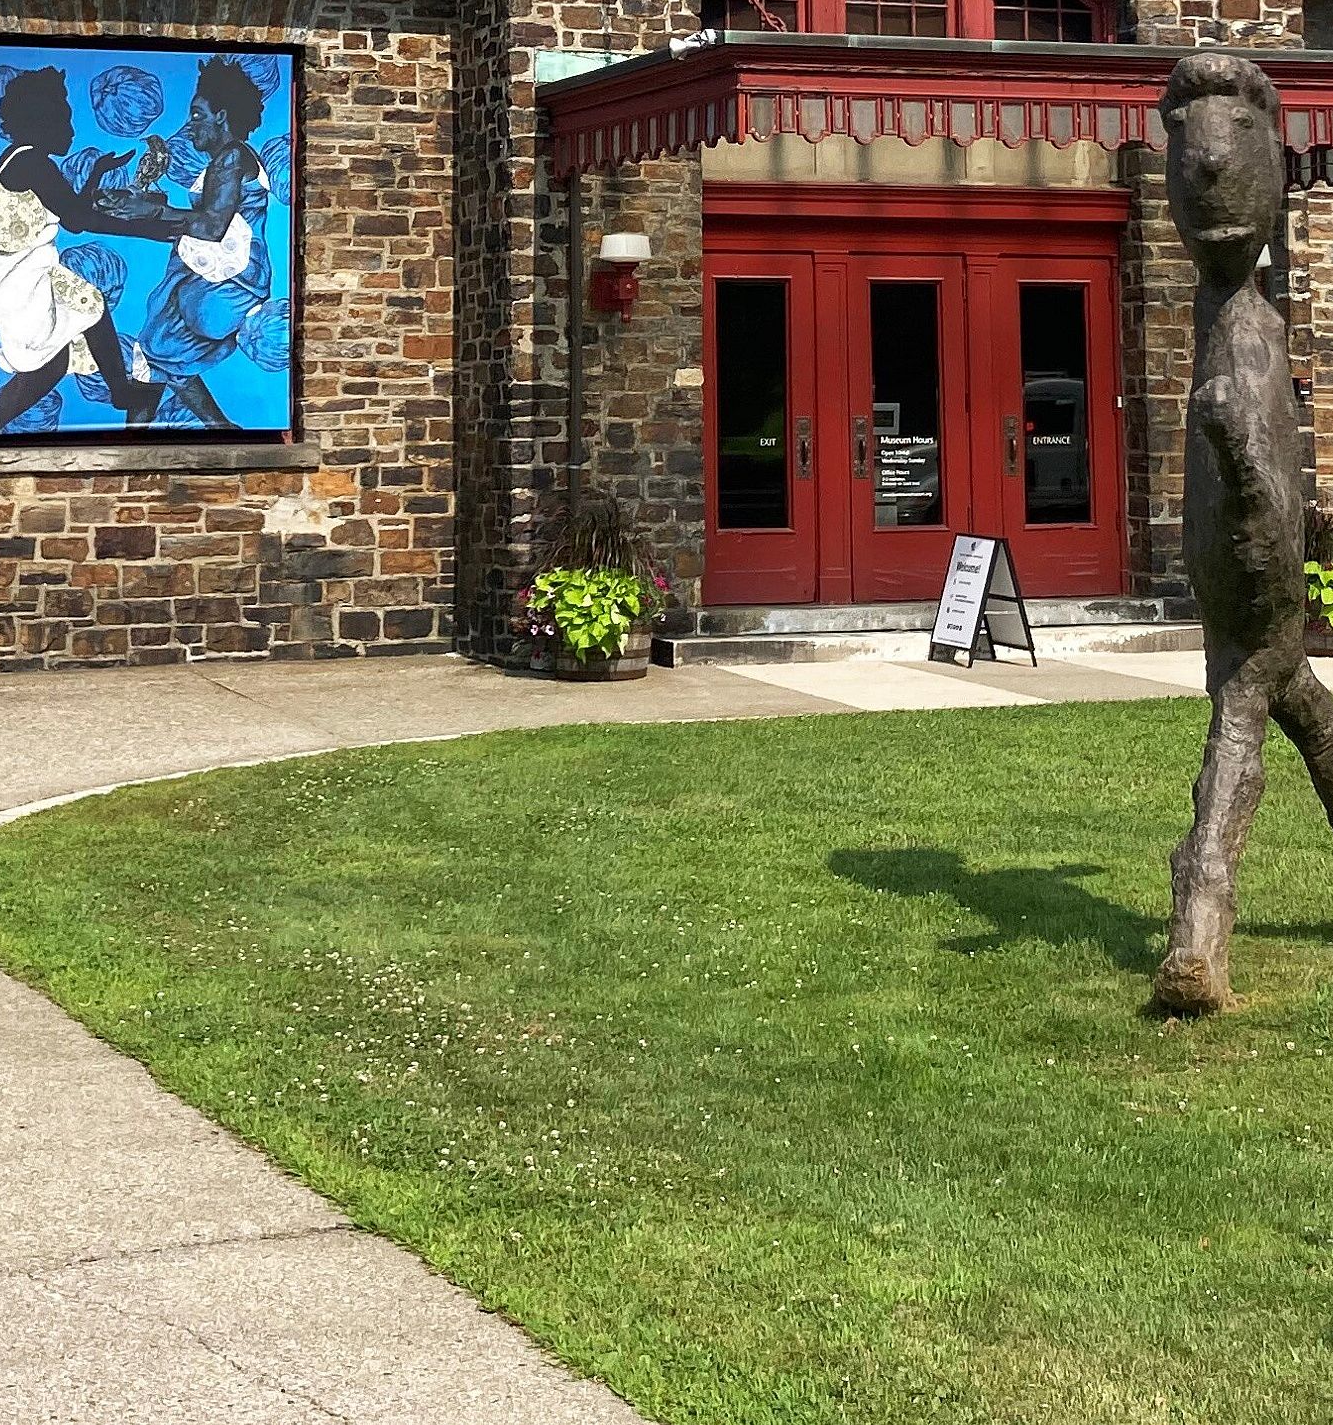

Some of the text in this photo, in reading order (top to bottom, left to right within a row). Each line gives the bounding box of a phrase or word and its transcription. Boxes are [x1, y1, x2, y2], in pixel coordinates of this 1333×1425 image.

[760, 437, 777, 446] EXIT
[880, 436, 934, 444] Museum Hours
[1032, 436, 1071, 444] ENTRANCE
